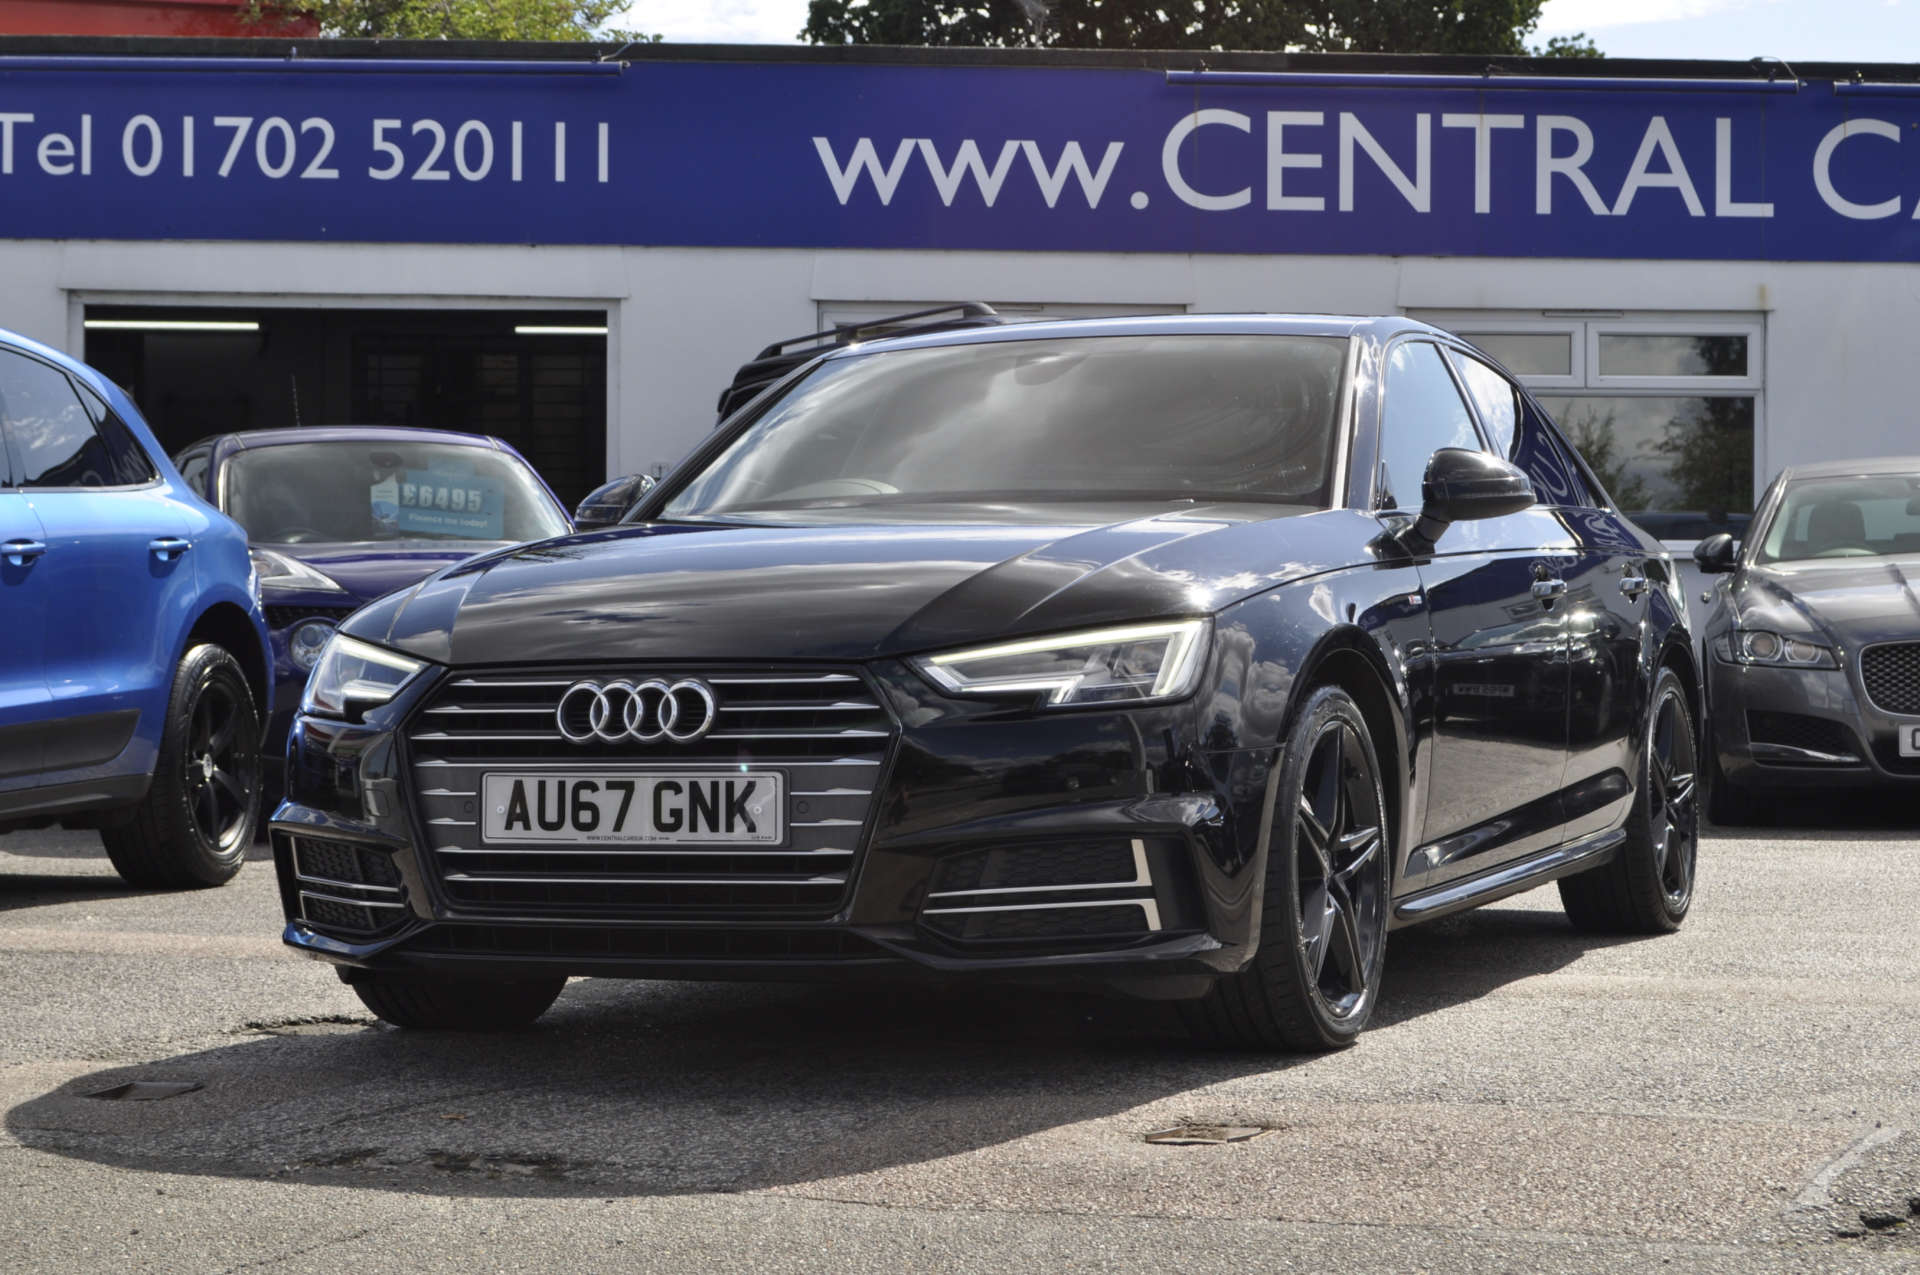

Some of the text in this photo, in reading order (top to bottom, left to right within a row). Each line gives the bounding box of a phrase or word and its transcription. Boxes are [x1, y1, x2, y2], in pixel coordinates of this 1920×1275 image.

[0, 112, 609, 183] Tel 01702 520111
[1813, 117, 1920, 221] C
[504, 779, 757, 834] AU67 GNK
